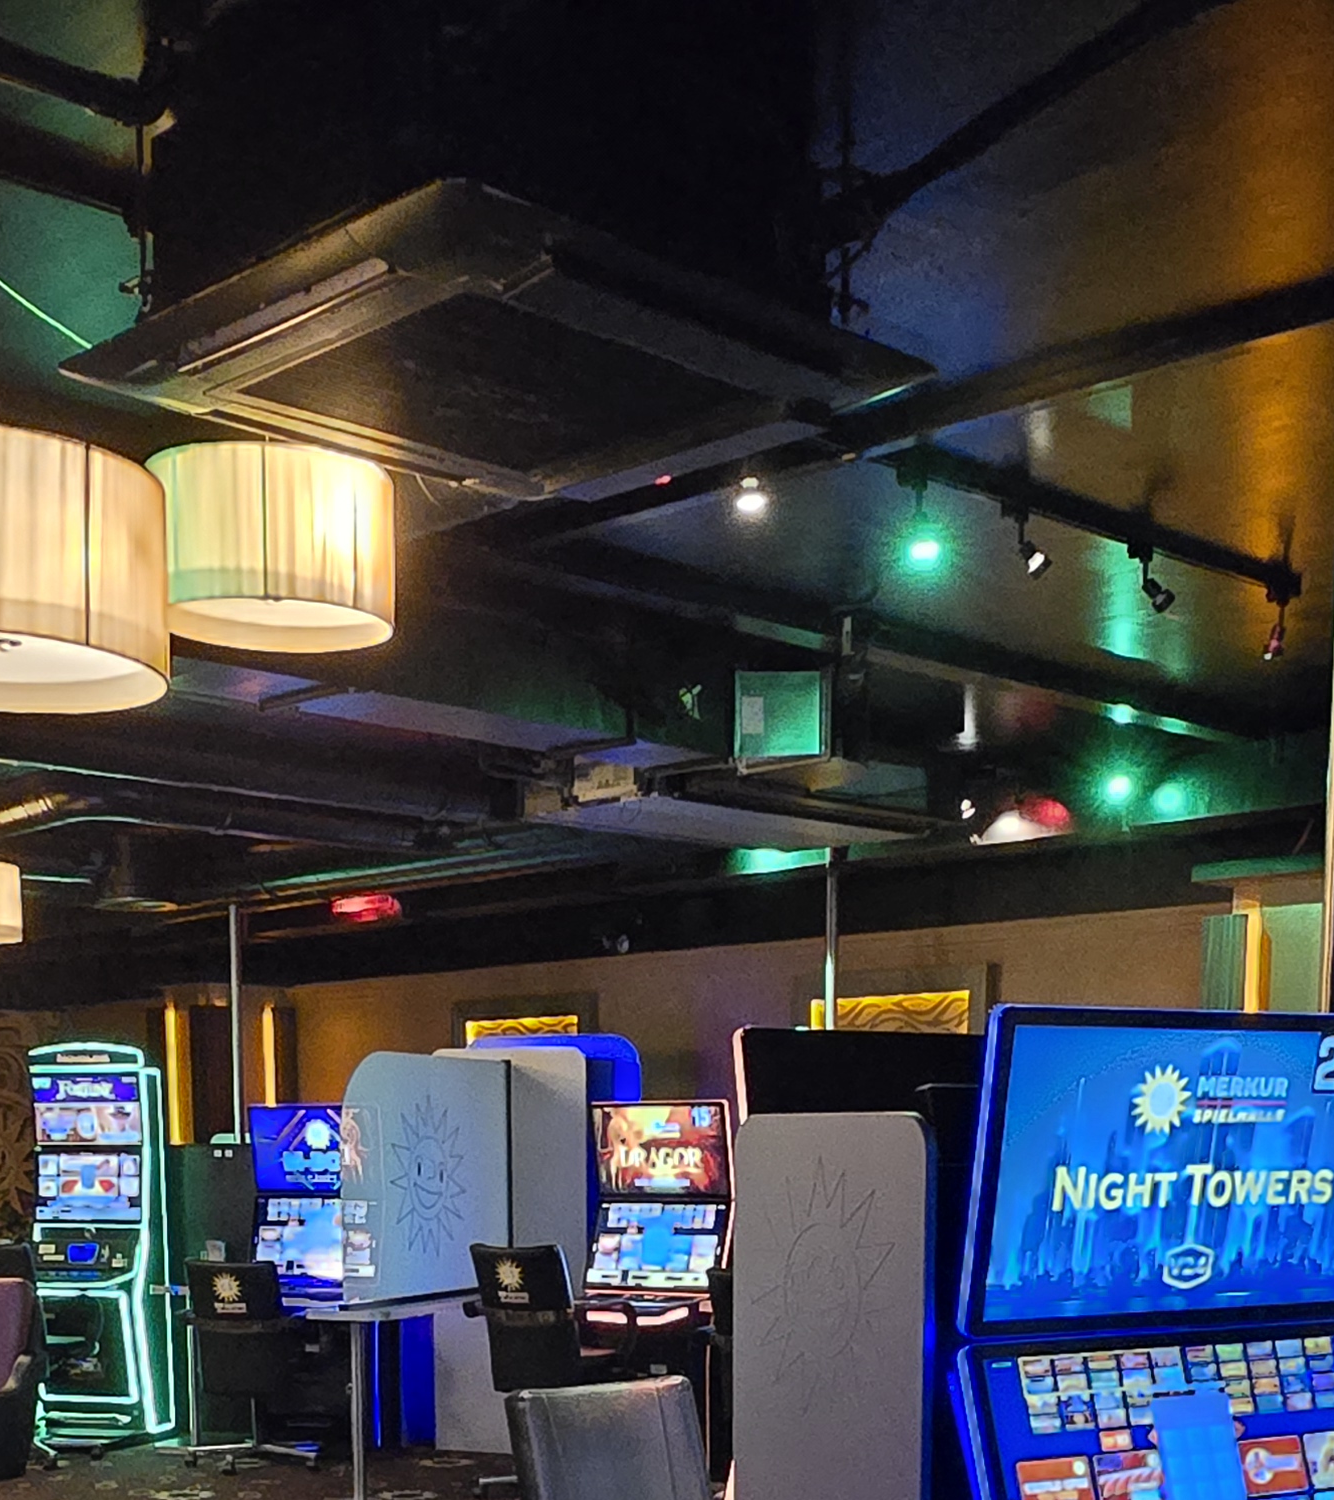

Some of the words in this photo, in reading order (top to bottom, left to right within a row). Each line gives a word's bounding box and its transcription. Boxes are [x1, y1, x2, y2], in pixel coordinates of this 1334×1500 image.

[1196, 1076, 1289, 1098] MERKUR
[692, 1106, 712, 1127] 15
[1052, 1165, 1178, 1212] NIGHT
[1185, 1164, 1334, 1207] TOWERS
